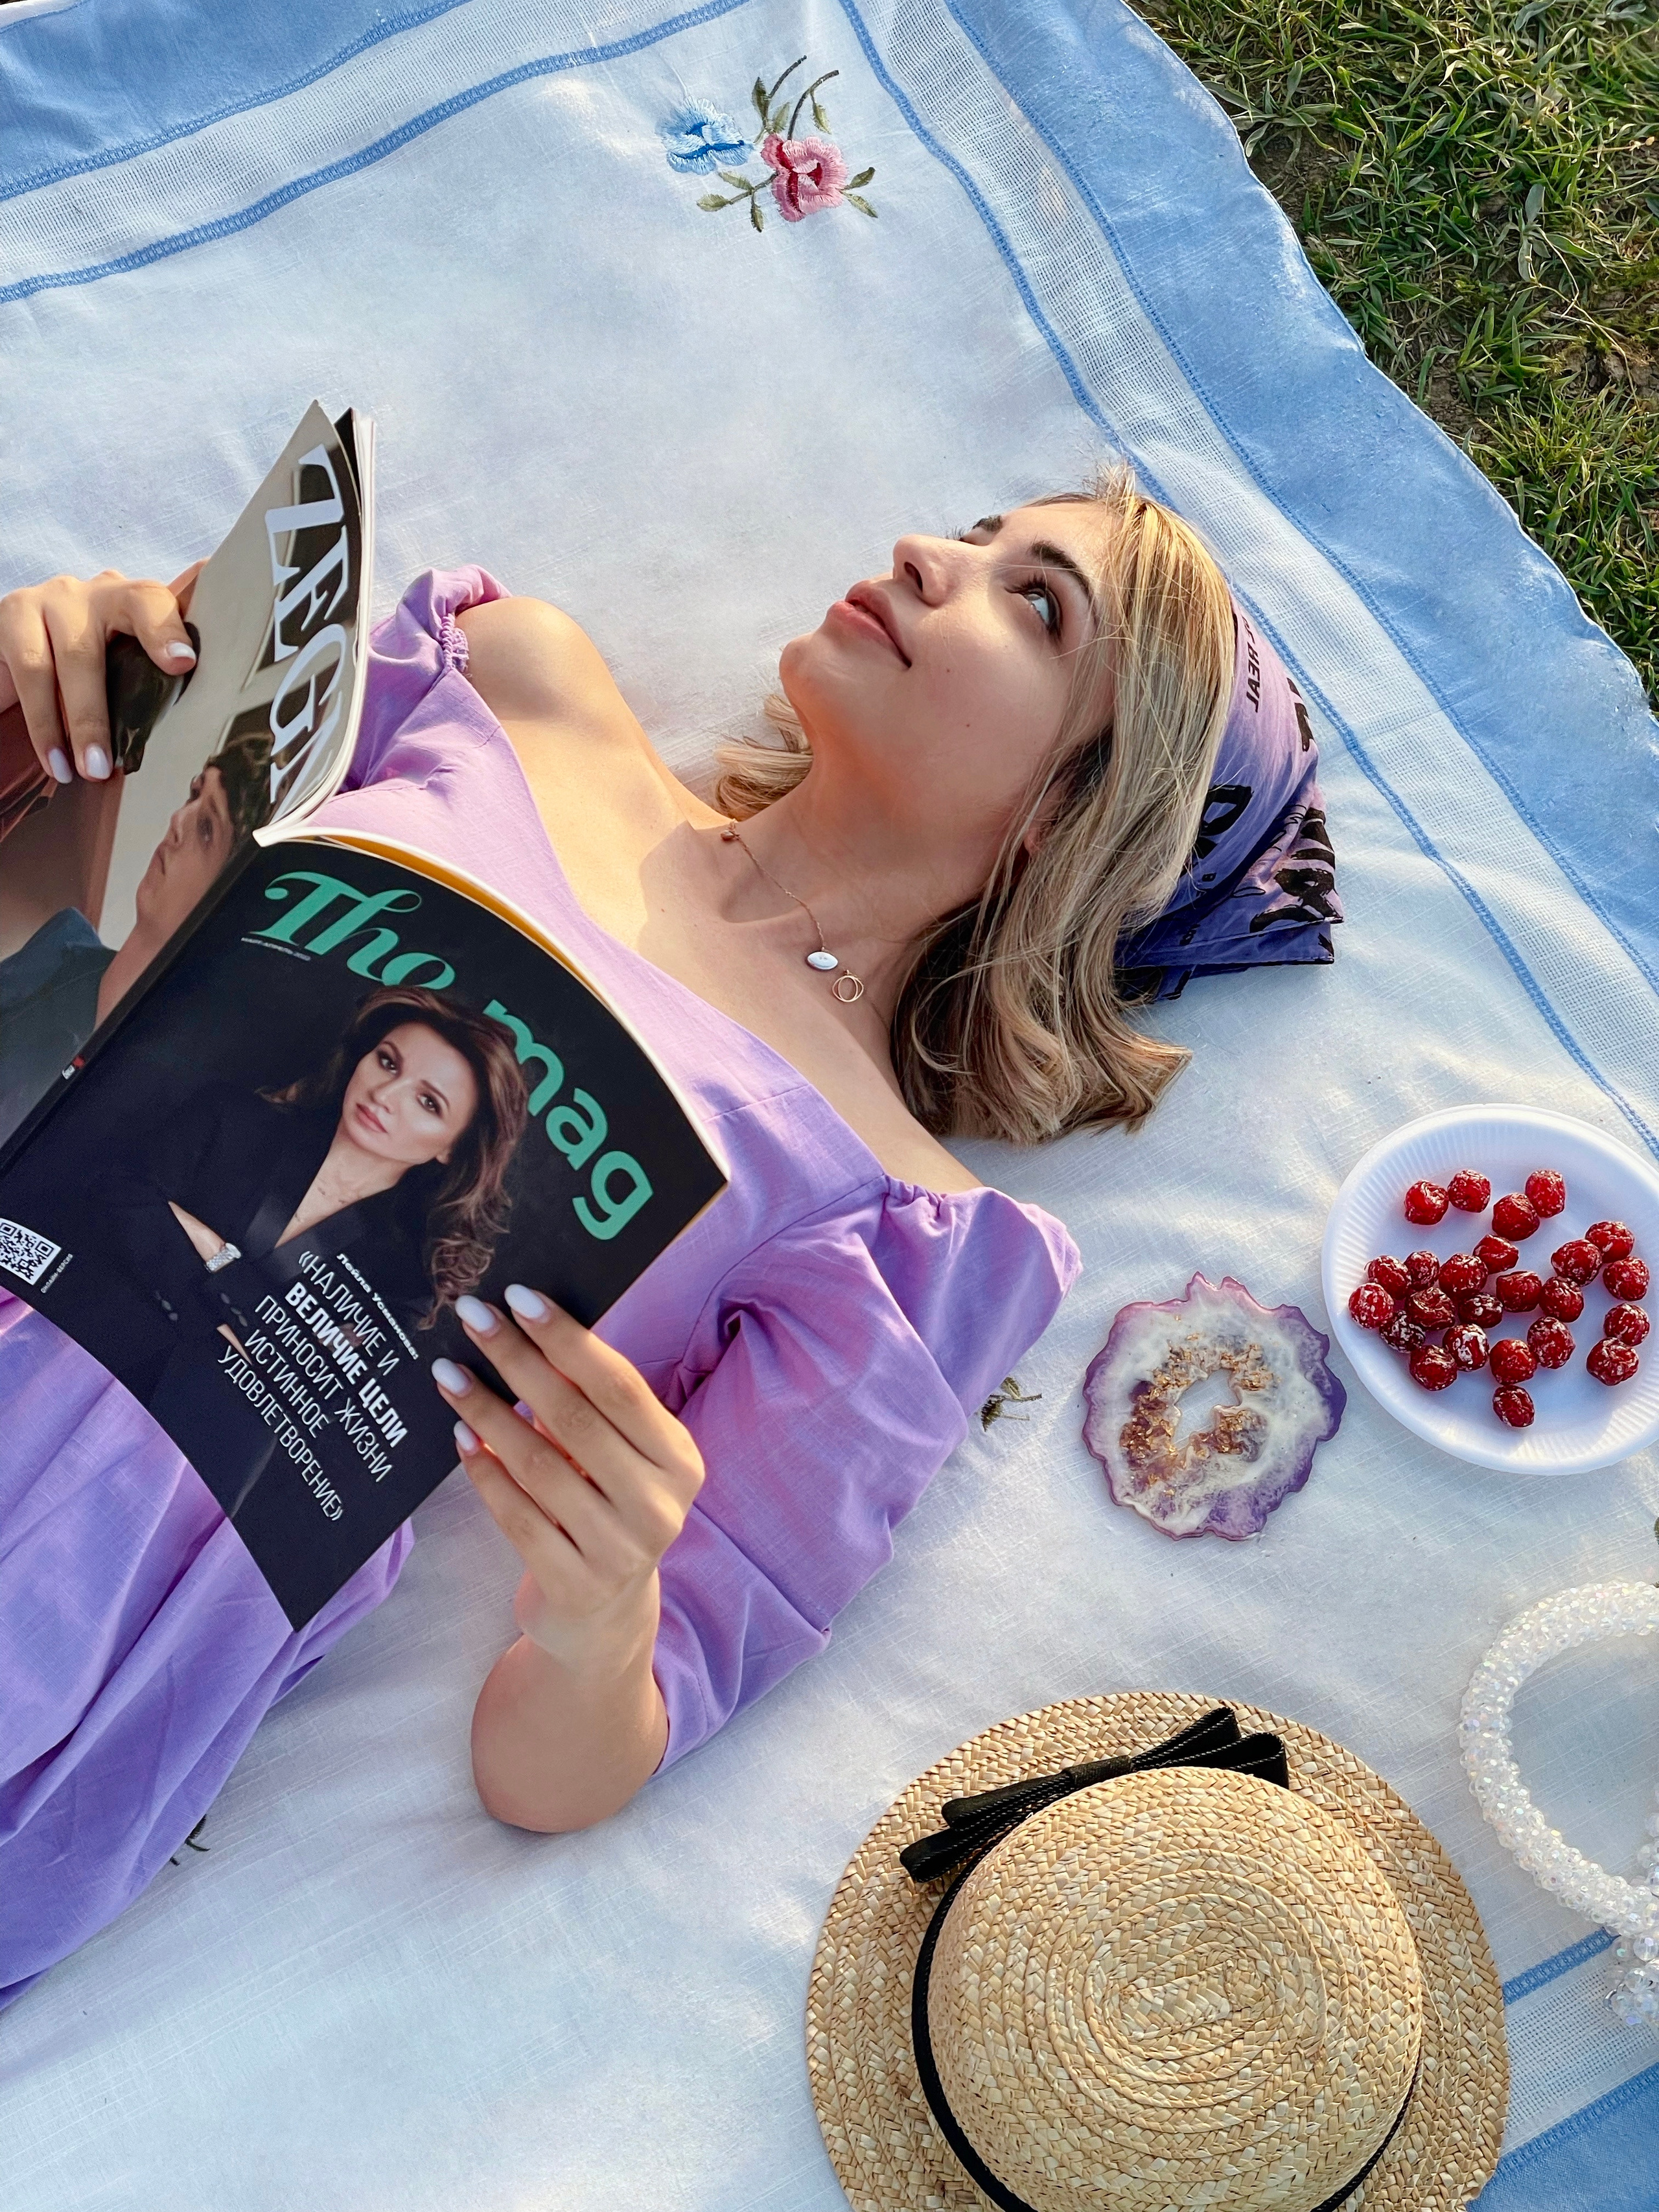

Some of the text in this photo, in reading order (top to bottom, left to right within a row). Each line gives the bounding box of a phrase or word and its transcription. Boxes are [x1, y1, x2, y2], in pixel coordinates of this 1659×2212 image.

[284, 1282, 408, 1447] ВЕЛИЧИЕ ЦЕЛИ
[299, 1251, 399, 1376] «НАЛИЧИЕ И
[336, 1253, 419, 1360] Лейла Усманова:
[218, 1346, 343, 1520] УДОВЛЕТВОРЕНИЕ»
[244, 1329, 330, 1438] ИСТИННОЕ
[255, 1295, 392, 1482] ПРИНОСИТ ЖИЗНИ
